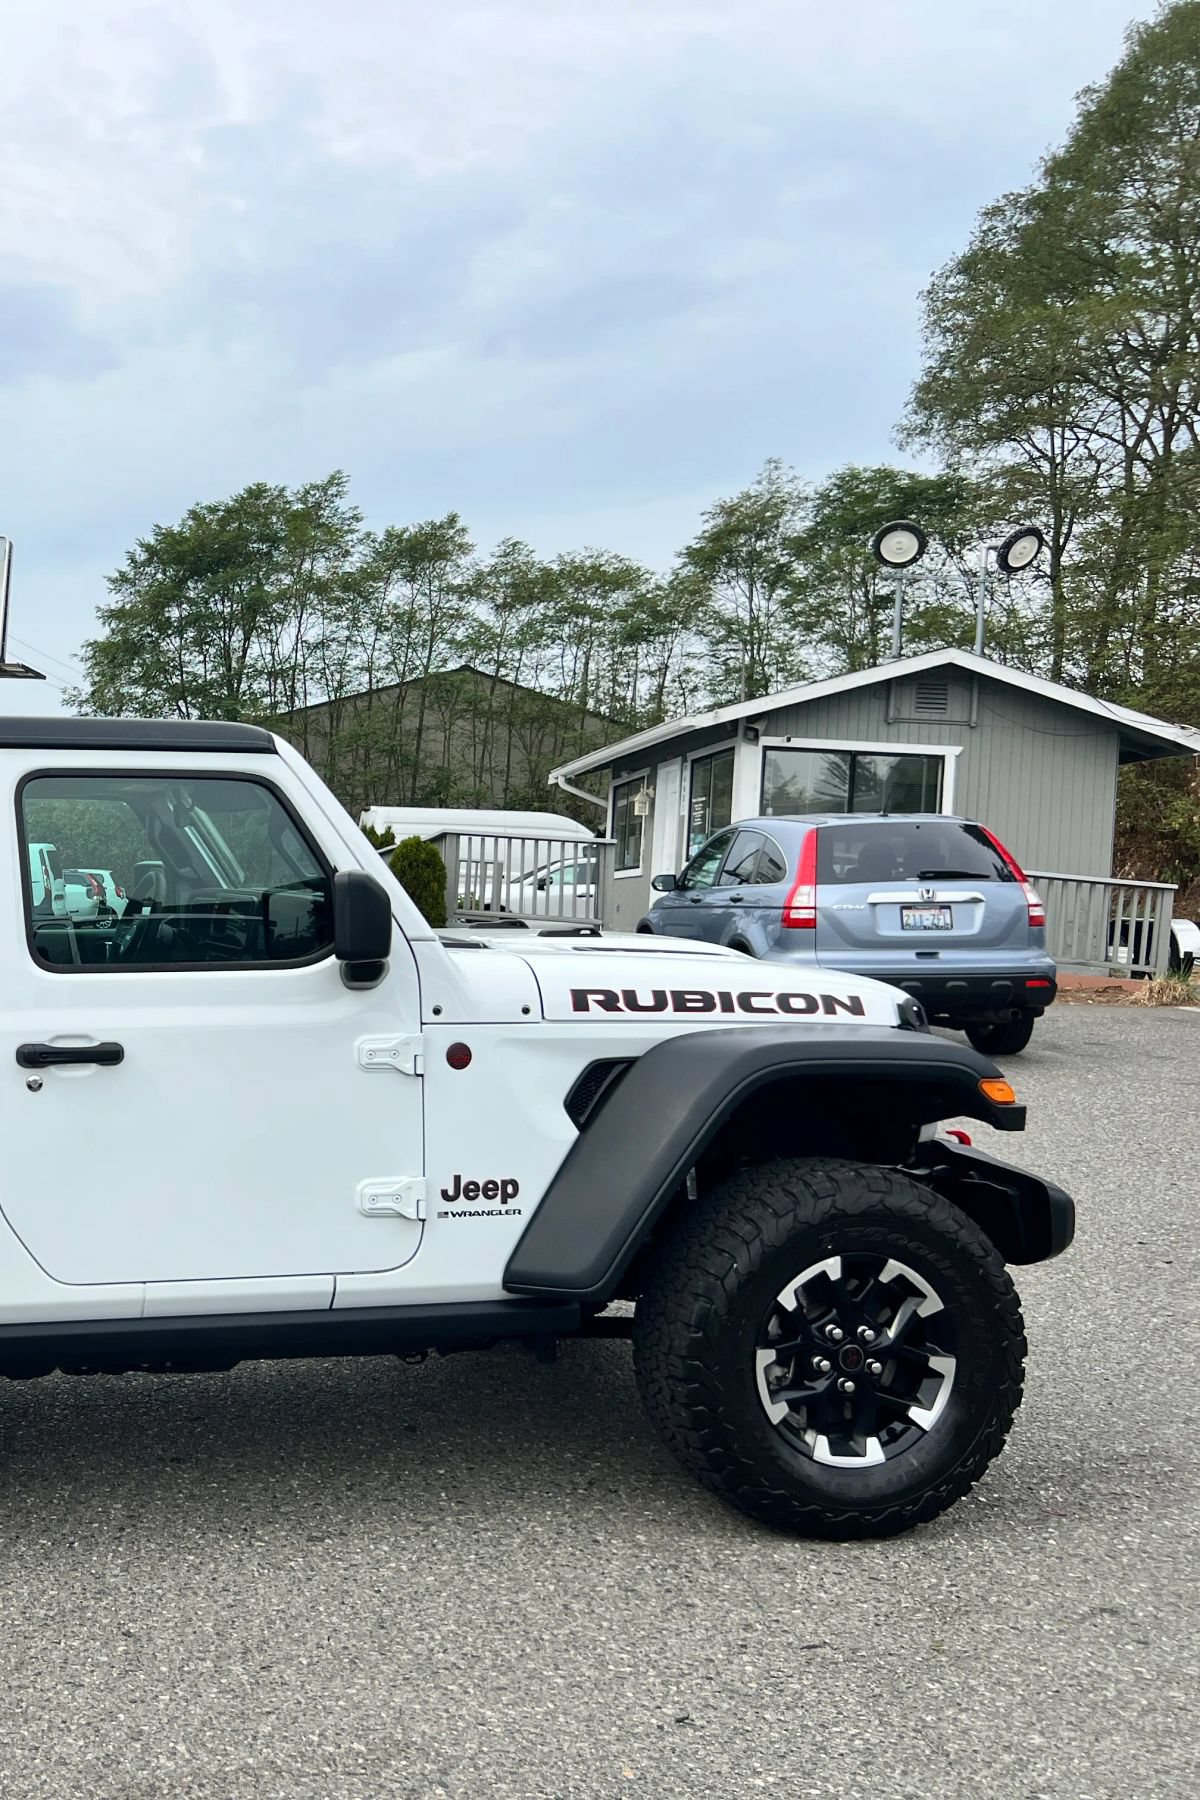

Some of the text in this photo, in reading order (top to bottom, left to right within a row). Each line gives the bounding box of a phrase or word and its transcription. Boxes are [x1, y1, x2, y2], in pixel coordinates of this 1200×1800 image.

[569, 988, 867, 1017] RUBICON
[440, 1174, 520, 1205] Jeep
[450, 1208, 522, 1218] WRANGLER
